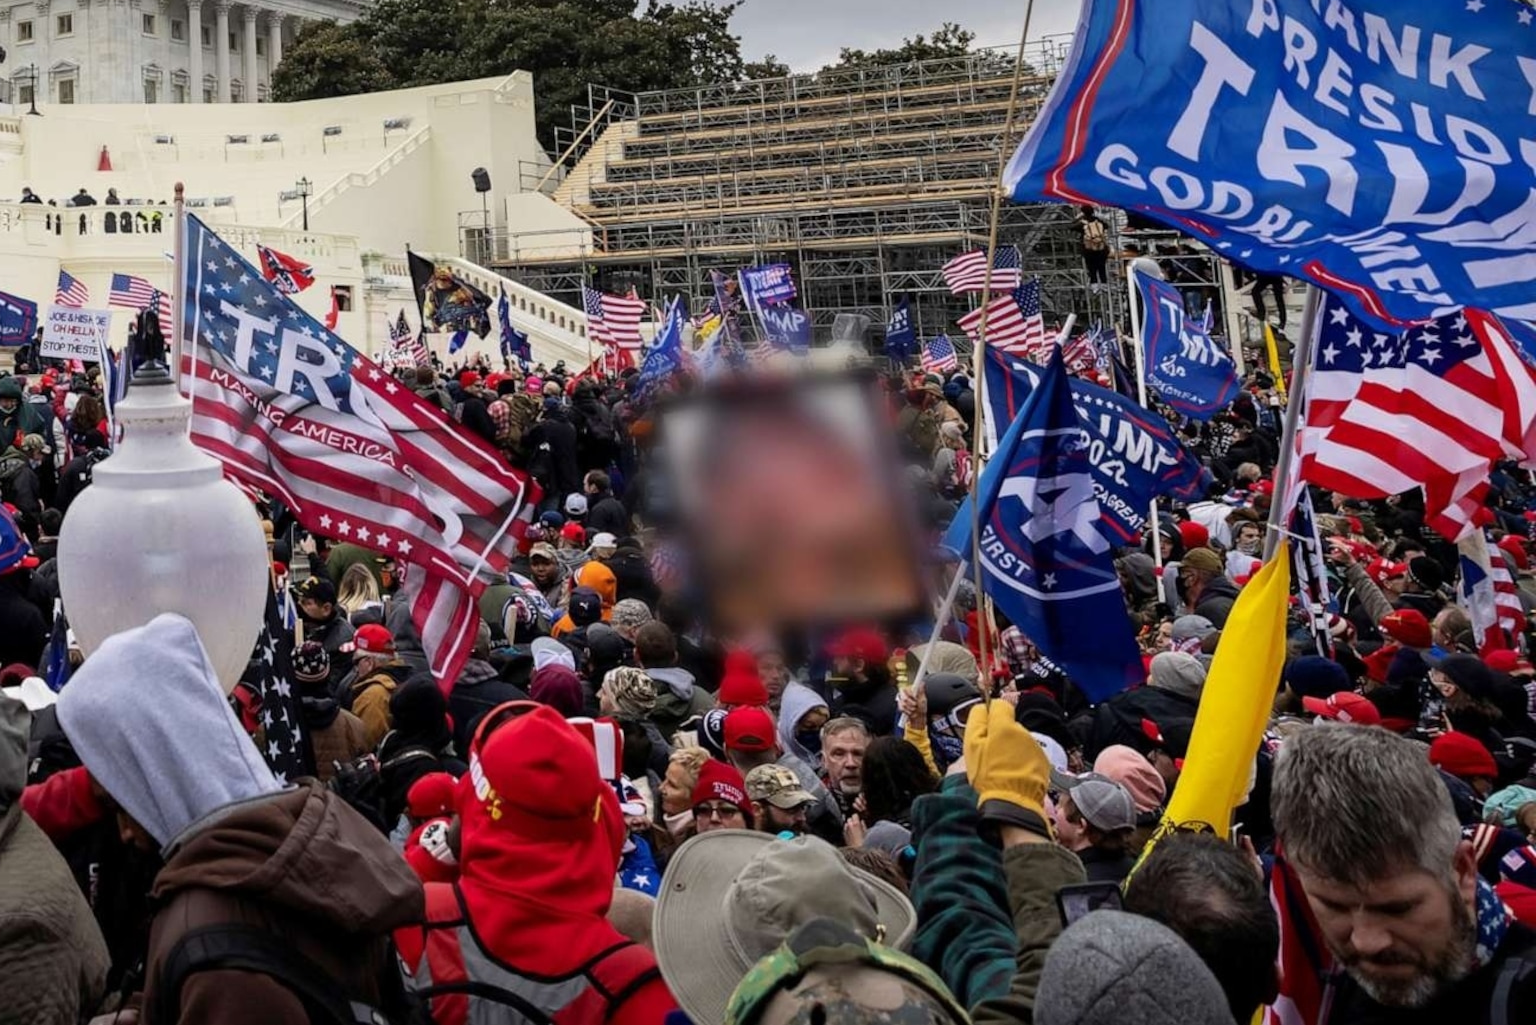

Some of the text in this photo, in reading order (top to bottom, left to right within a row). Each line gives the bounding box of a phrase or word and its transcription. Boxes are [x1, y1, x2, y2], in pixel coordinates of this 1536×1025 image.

[49, 312, 67, 322] JOE
[53, 323, 67, 333] OH
[43, 340, 65, 352] STOP
[210, 369, 396, 468] MAKING AMERICA
